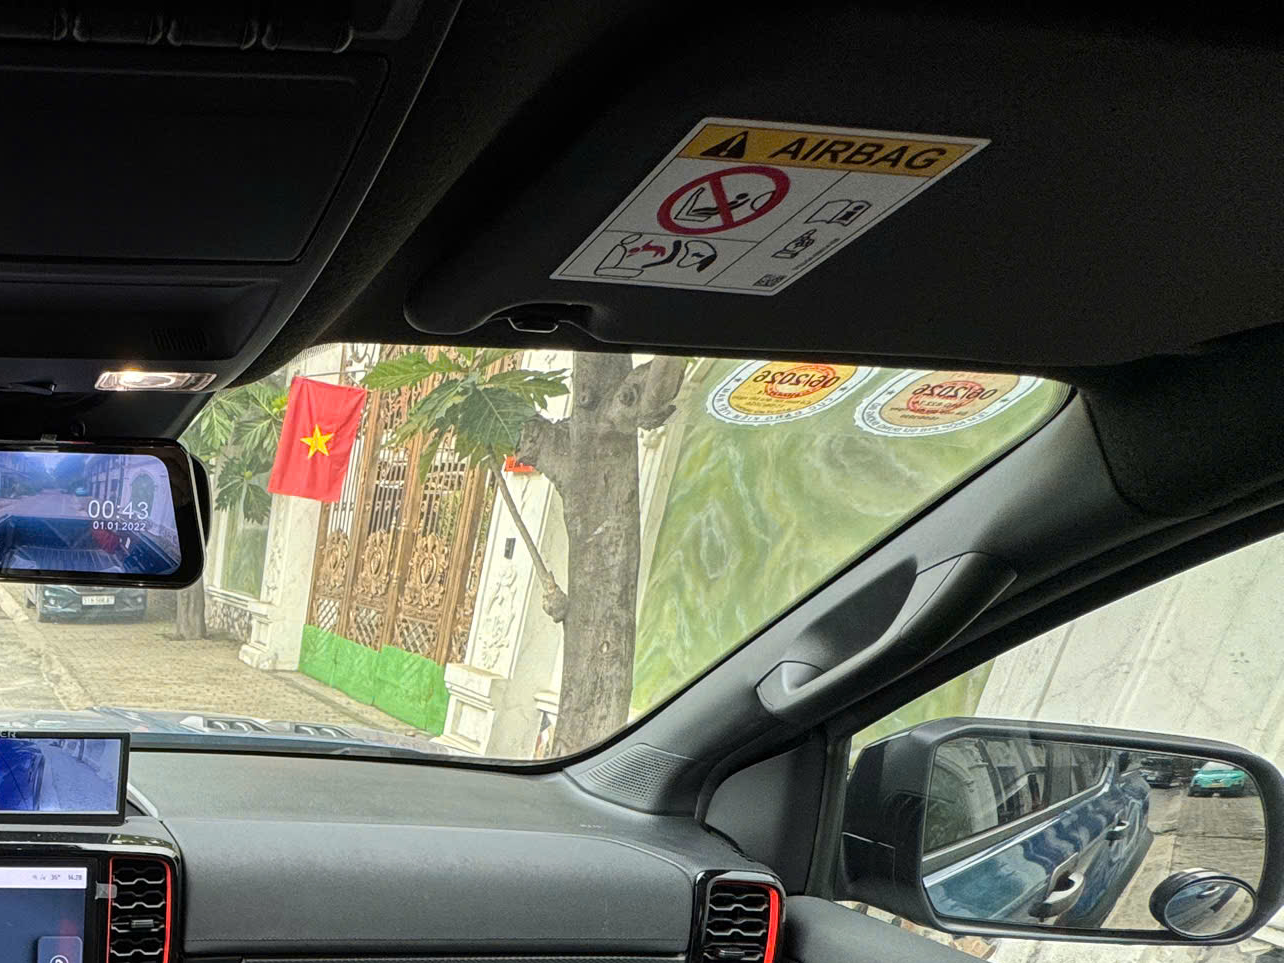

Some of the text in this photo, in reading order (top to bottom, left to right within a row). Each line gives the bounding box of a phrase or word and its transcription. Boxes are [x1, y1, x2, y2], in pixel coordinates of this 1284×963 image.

[768, 137, 946, 171] AIRBAG
[88, 500, 149, 519] 00:43
[93, 520, 146, 531] 01.01.2022
